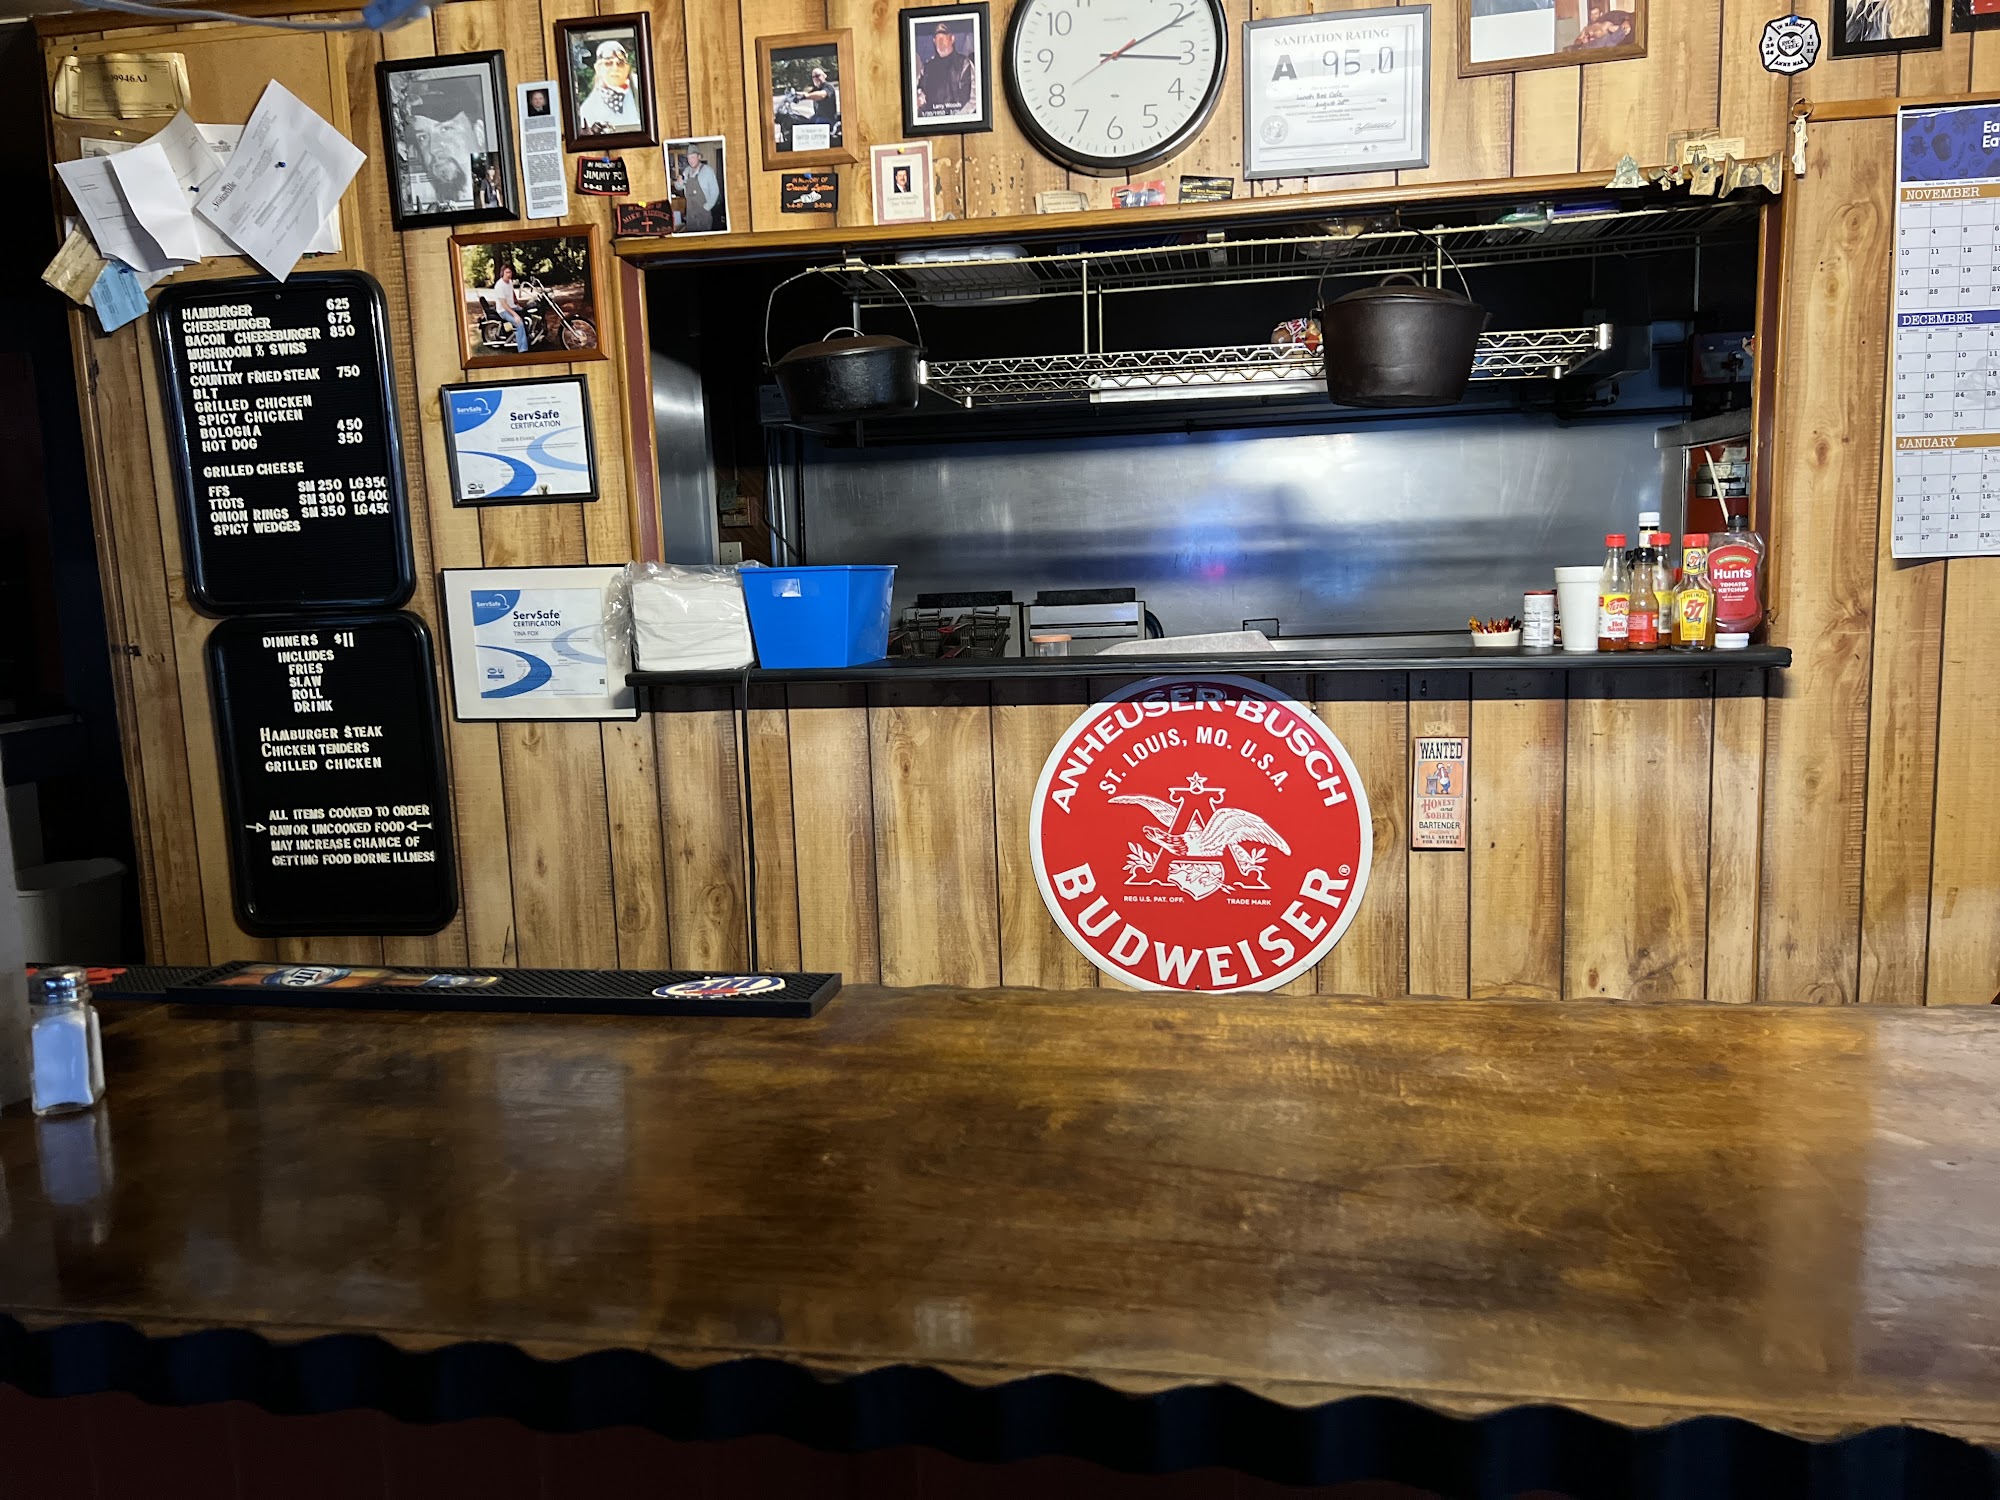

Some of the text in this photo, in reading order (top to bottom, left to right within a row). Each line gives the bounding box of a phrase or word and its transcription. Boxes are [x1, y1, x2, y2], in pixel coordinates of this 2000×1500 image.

[1048, 11, 1072, 36] 10
[1169, 3, 1184, 27] 2
[1274, 28, 1389, 46] SANITATION RATING
[1037, 49, 1054, 73] 9
[1178, 40, 1195, 65] 3
[1272, 55, 1297, 82] A
[1049, 83, 1065, 107] 8
[1168, 77, 1184, 101] 4
[1074, 109, 1089, 133] 7
[1142, 104, 1158, 128] 5
[1107, 116, 1123, 140] 6
[1984, 121, 2000, 133] Ea
[1983, 135, 2000, 147] Ea
[583, 170, 610, 180] JIMMY
[1906, 187, 1980, 200] NOVEMBER
[182, 298, 350, 320] HAMBURGER 625
[183, 312, 351, 334] CHEESEBURGER 675
[1902, 313, 1973, 325] DECEMBER
[185, 325, 355, 347] BACON CHEESEBURGER 850
[187, 345, 252, 361] MUSHROOM
[269, 342, 307, 356] SWISS
[190, 360, 232, 374] PHILLY
[190, 365, 360, 388] COUNTRY FRIED STEAK 750
[195, 395, 312, 414] GRILLED CHICKEN
[198, 409, 303, 426] SPICY CHICKEN
[510, 410, 559, 421] ServSafe
[200, 418, 363, 439] BOLOGNA 450
[510, 420, 561, 430] CERTIFICATION
[202, 432, 363, 452] HOT DOG 350
[1900, 437, 1958, 448] JANUARY
[203, 462, 304, 478] GRILLED CHEESE
[208, 485, 230, 497] FFS
[298, 480, 315, 493] SM
[318, 478, 342, 491] 250
[349, 477, 364, 490] LG
[208, 498, 244, 511] TTOTS
[299, 493, 316, 506] SM
[319, 491, 344, 504] 300
[351, 490, 366, 503] LG
[210, 510, 248, 523] ONION
[253, 508, 289, 521] RINGS
[301, 506, 318, 519] SM
[320, 504, 346, 517] 350
[354, 503, 368, 516] LG
[214, 520, 300, 536] SPICY WEDGES
[513, 610, 560, 620] ServSafe
[1684, 600, 1705, 619] 57
[262, 632, 354, 648] DINNERS $11
[278, 650, 334, 663] INCLUDES
[288, 663, 324, 675] FRIES
[289, 675, 322, 688] SLAW
[292, 688, 323, 700] ROLL
[294, 700, 333, 713] DRINK
[260, 725, 383, 742] HAMBURGER STEAK
[261, 742, 370, 757] CHICKEN TENDERS
[1051, 686, 1348, 814] ANHEUSER-BUSCH
[1420, 742, 1462, 759] WANTED
[265, 757, 382, 773] GRILLED CHICKEN
[1099, 726, 1289, 795] ST. LOUIS, MO. U.S.A.
[269, 804, 430, 820] ALL ITEMS COOKED TO ORDER
[1421, 799, 1455, 812] HONEST
[270, 821, 405, 836] RAW OR UNCOOKED FOOD
[271, 836, 420, 851] MAY INCREASE CHANCE OF
[272, 850, 435, 866] GETTING FOOD BORNE ILLNESS
[1053, 863, 1350, 986] BUDWEISER
